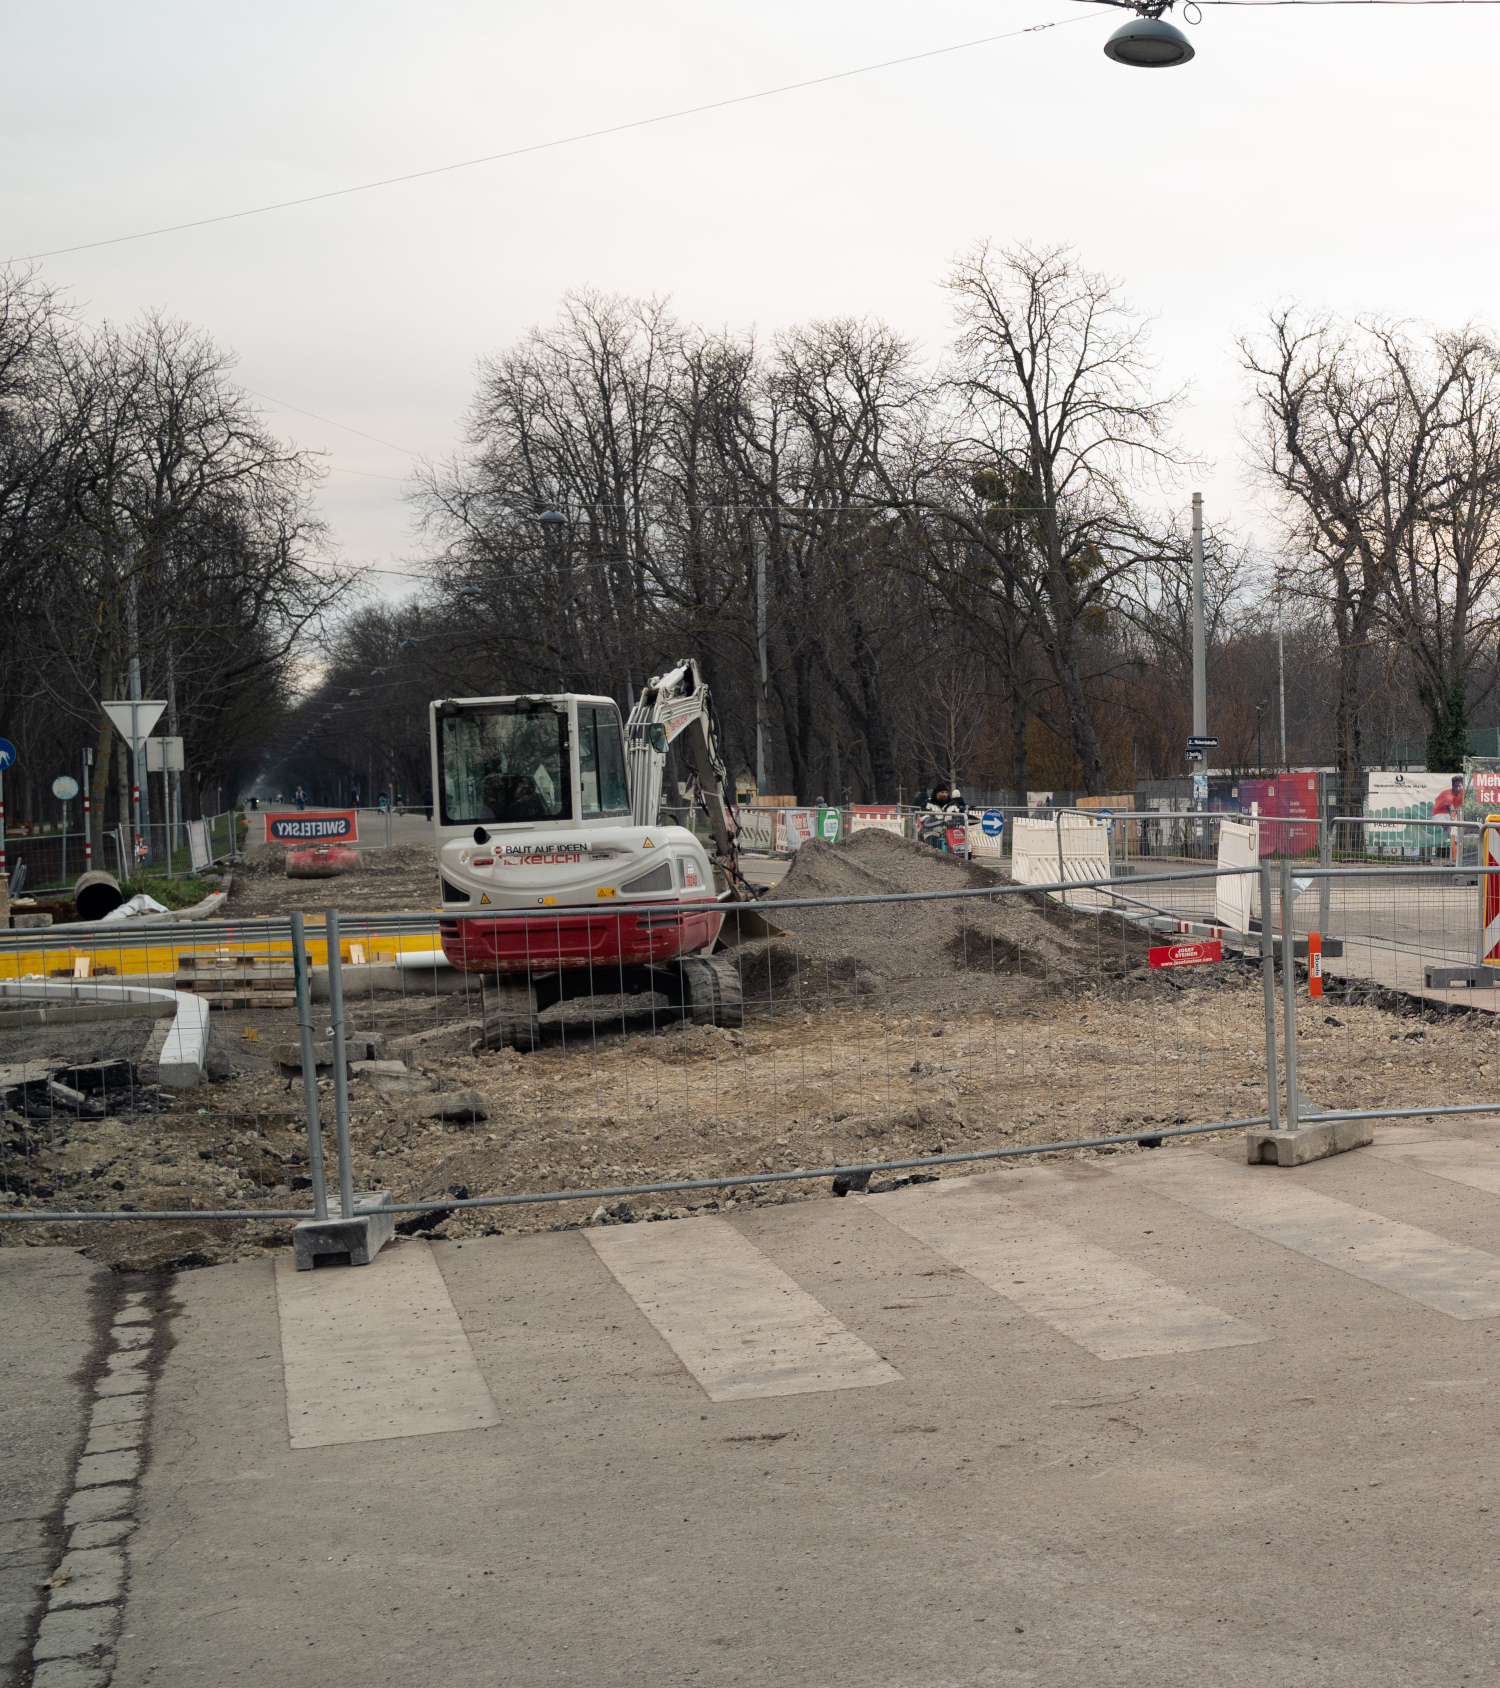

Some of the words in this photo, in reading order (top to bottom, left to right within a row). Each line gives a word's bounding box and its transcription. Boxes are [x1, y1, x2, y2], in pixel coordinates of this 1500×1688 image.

[1480, 789, 1495, 803] ist
[505, 845, 532, 854] BAUT
[535, 845, 555, 853] AUF
[557, 843, 588, 852] IDEEN
[1174, 951, 1198, 959] STEINER
[1177, 946, 1195, 954] JOSEF
[1160, 957, 1213, 967] www.josefsteiner.com
